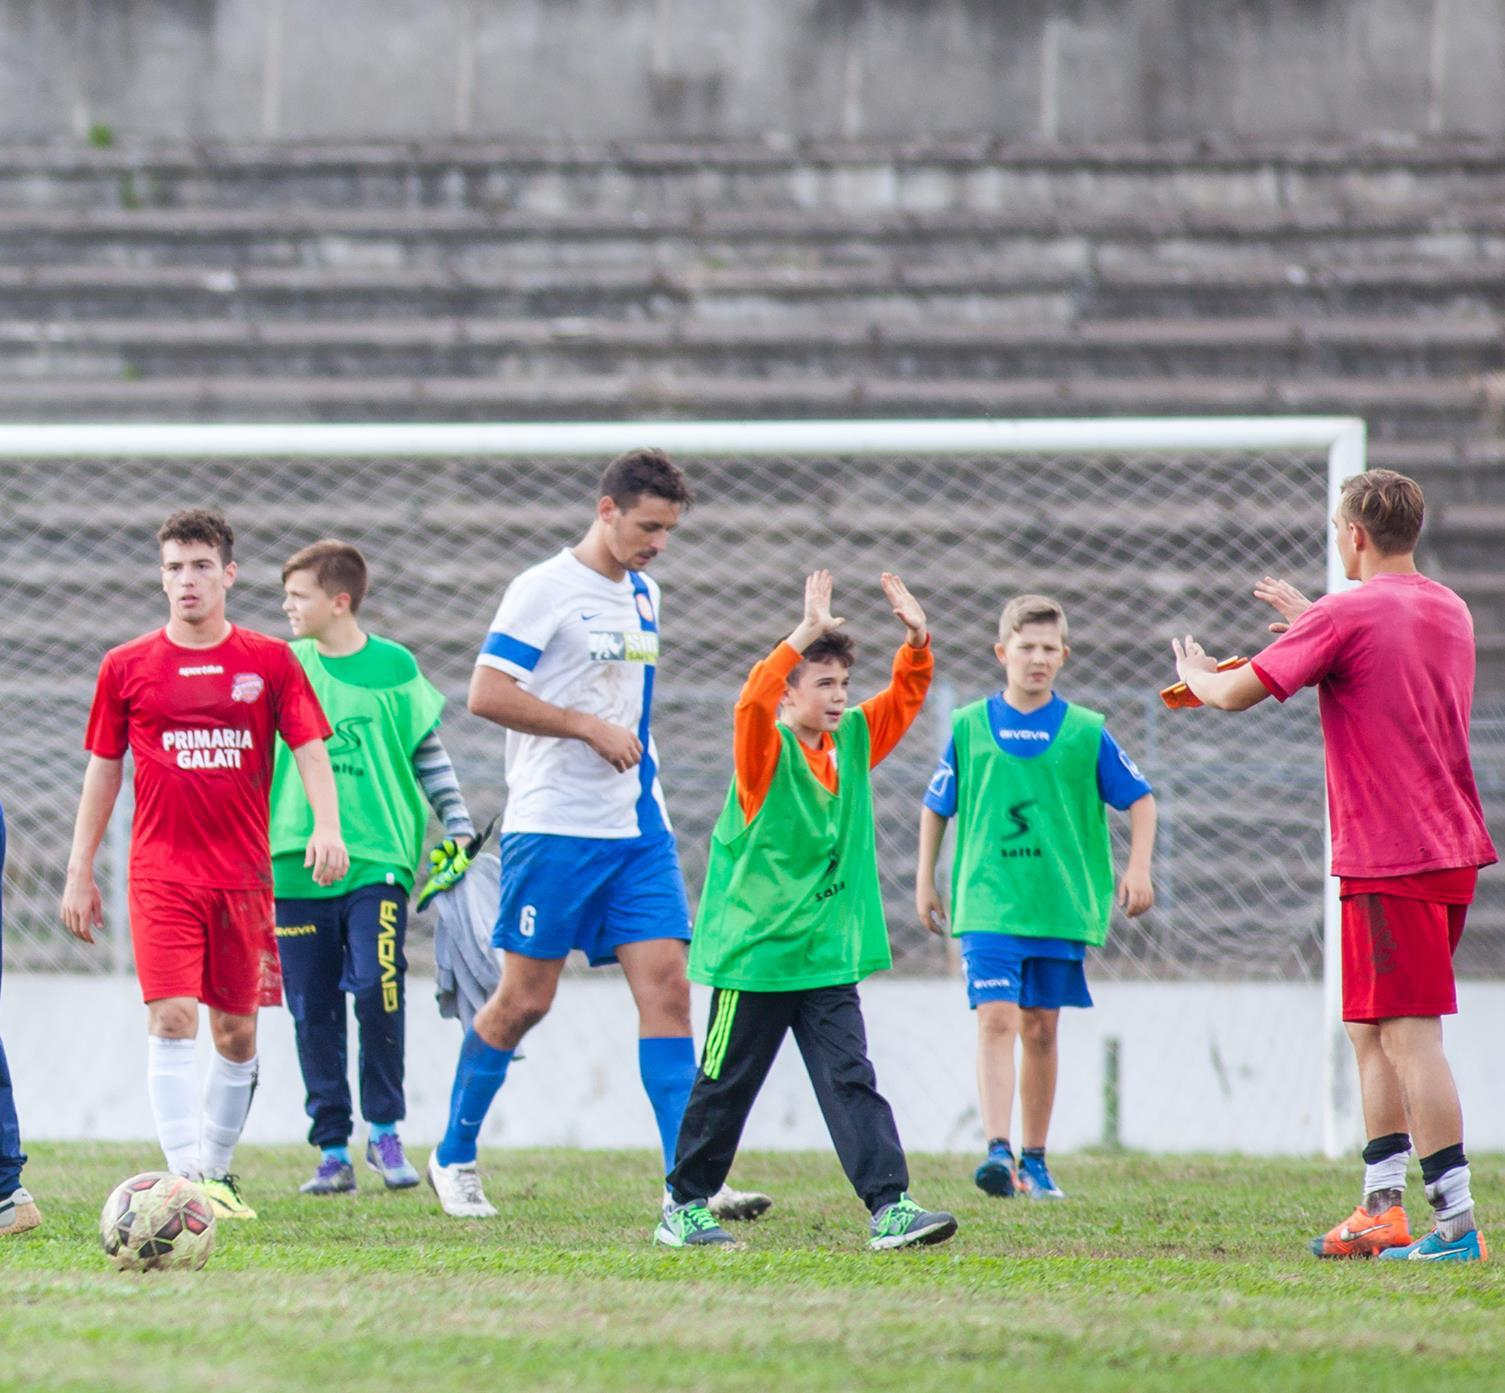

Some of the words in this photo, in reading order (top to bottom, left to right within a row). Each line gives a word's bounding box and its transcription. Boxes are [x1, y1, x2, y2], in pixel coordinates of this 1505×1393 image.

[162, 728, 254, 752] PRIMARIA
[999, 729, 1051, 742] GIVOVA
[177, 747, 242, 770] GALATI
[519, 904, 537, 937] 6
[377, 899, 399, 1013] GIVOVA
